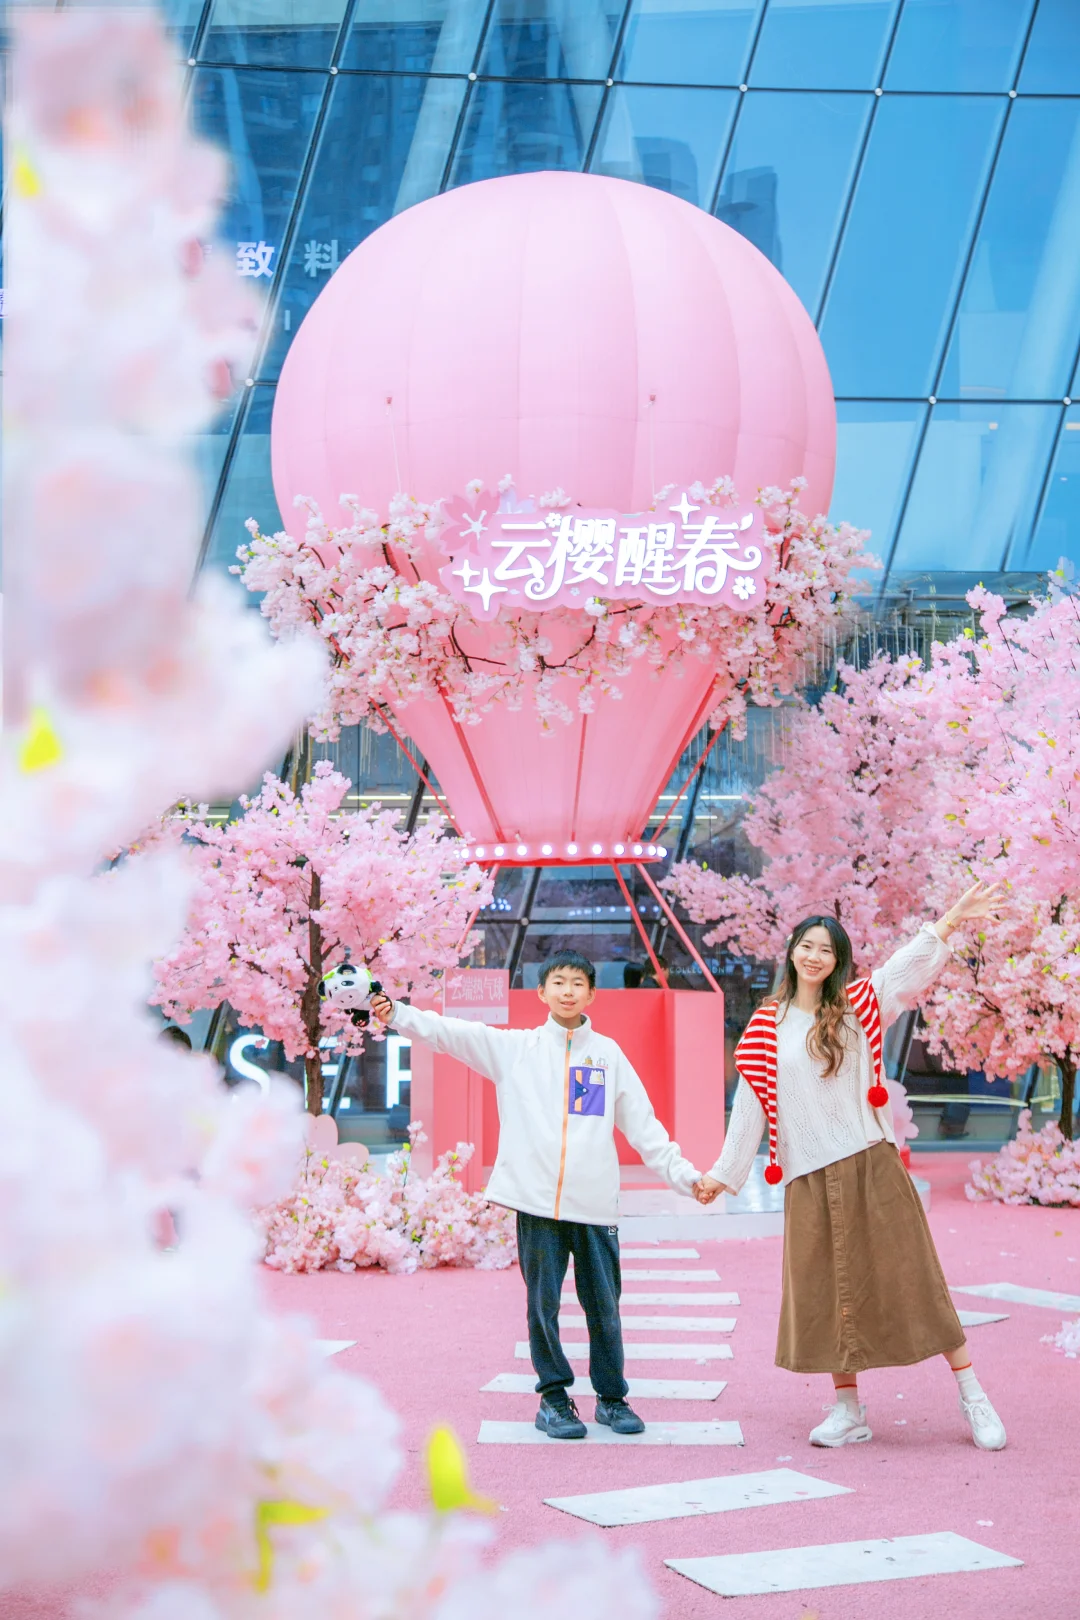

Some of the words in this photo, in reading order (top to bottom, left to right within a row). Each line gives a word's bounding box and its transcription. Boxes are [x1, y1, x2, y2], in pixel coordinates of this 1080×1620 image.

[490, 513, 763, 600] 云樱醒春
[669, 965, 725, 974] COLLECON
